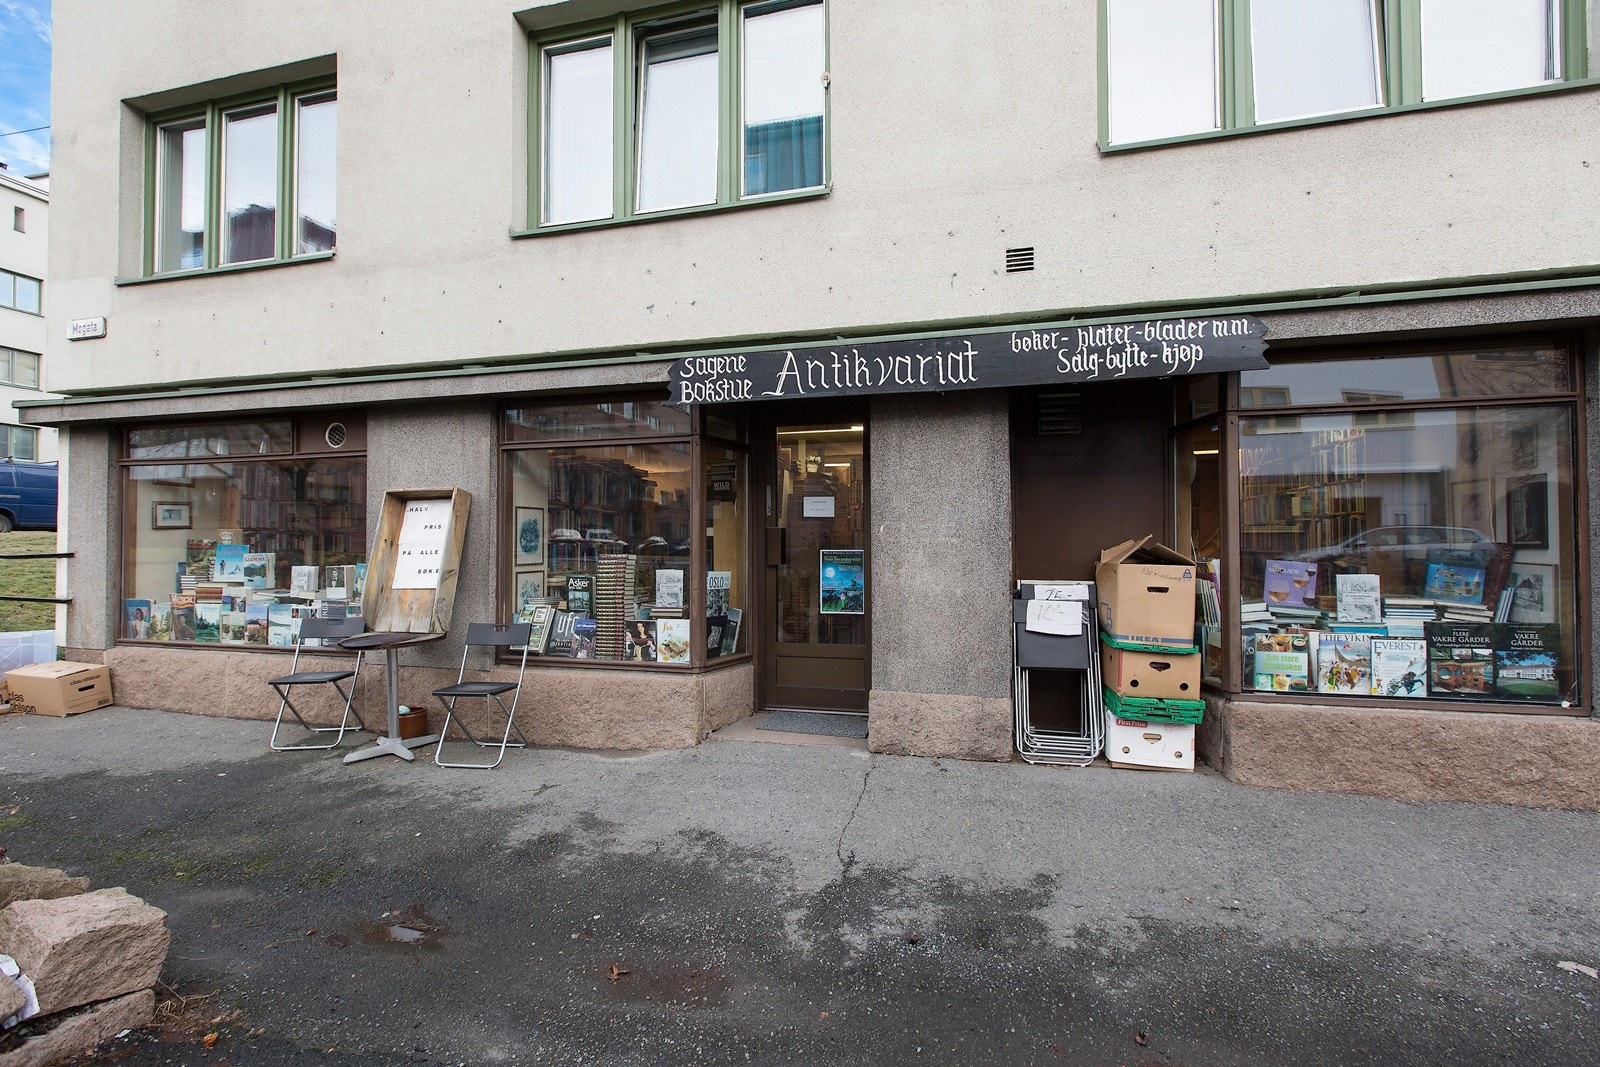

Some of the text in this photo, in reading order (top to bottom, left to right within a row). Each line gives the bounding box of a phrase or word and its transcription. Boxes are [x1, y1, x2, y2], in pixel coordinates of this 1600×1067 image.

[762, 340, 979, 396] Antikvariat
[677, 378, 753, 406] Bokstue
[568, 578, 589, 588] Asker
[709, 576, 724, 588] OSLO
[1458, 636, 1490, 644] GÅRDER
[1374, 642, 1418, 652] EVEREST
[1263, 662, 1302, 671] drinkboken
[83, 674, 102, 682] ohlson
[8, 690, 24, 702] clas
[10, 702, 37, 713] ohlson
